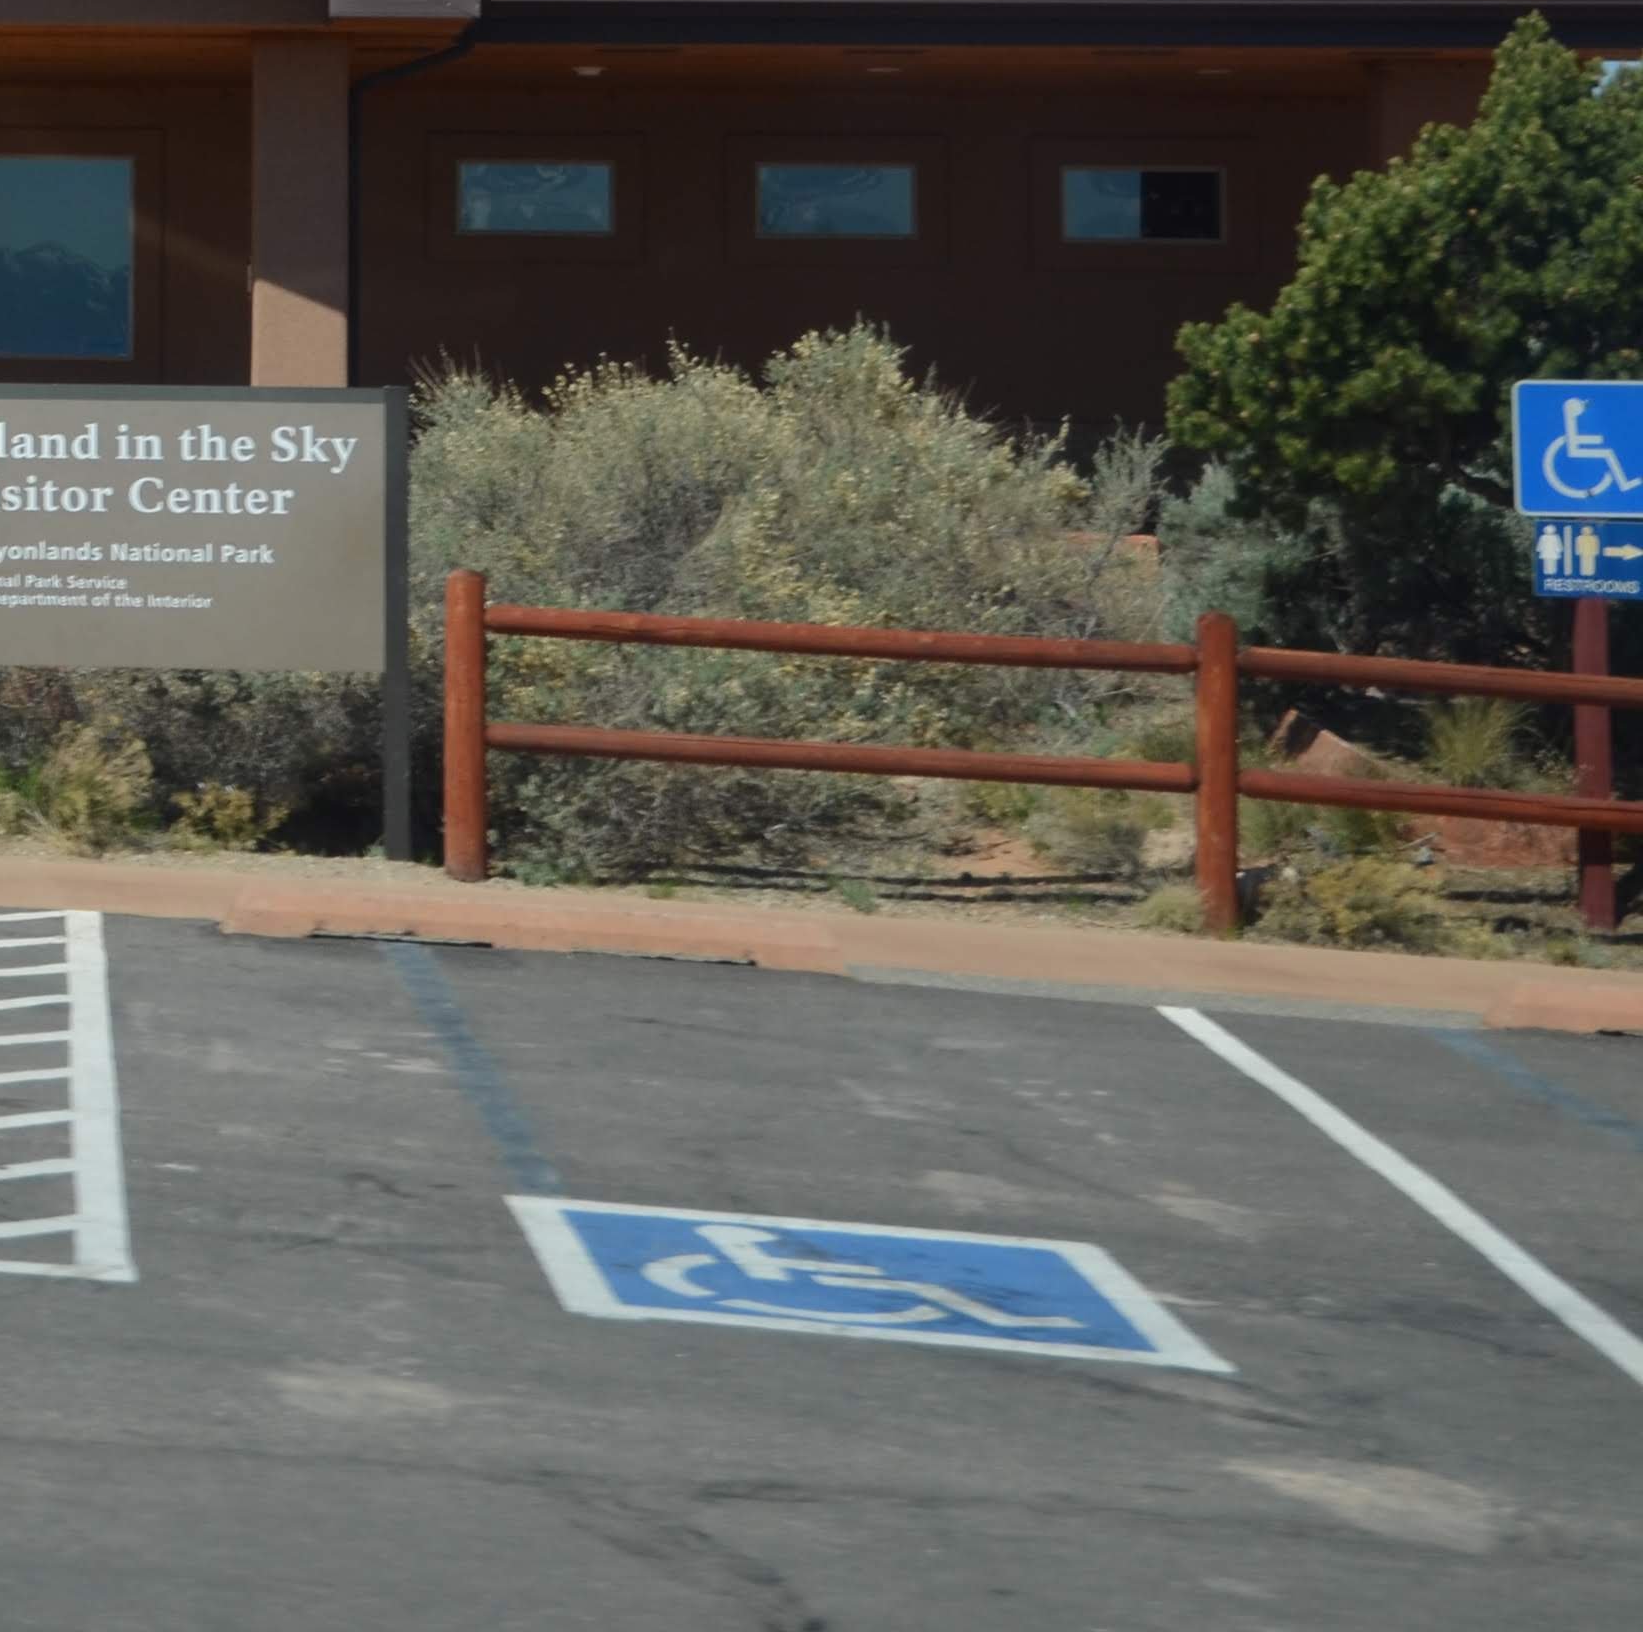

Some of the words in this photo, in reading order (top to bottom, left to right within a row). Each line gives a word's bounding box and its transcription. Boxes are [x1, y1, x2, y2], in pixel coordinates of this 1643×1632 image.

[115, 423, 164, 460] in
[177, 424, 256, 462] the
[270, 425, 359, 475] Sky
[128, 476, 295, 515] Center
[110, 542, 214, 563] National
[219, 544, 276, 564] Park
[24, 575, 62, 588] Park
[66, 575, 128, 590] Service
[1543, 578, 1640, 594] RESTROOMS
[91, 593, 111, 607] of
[114, 594, 144, 608] the
[147, 594, 214, 609] Interior
